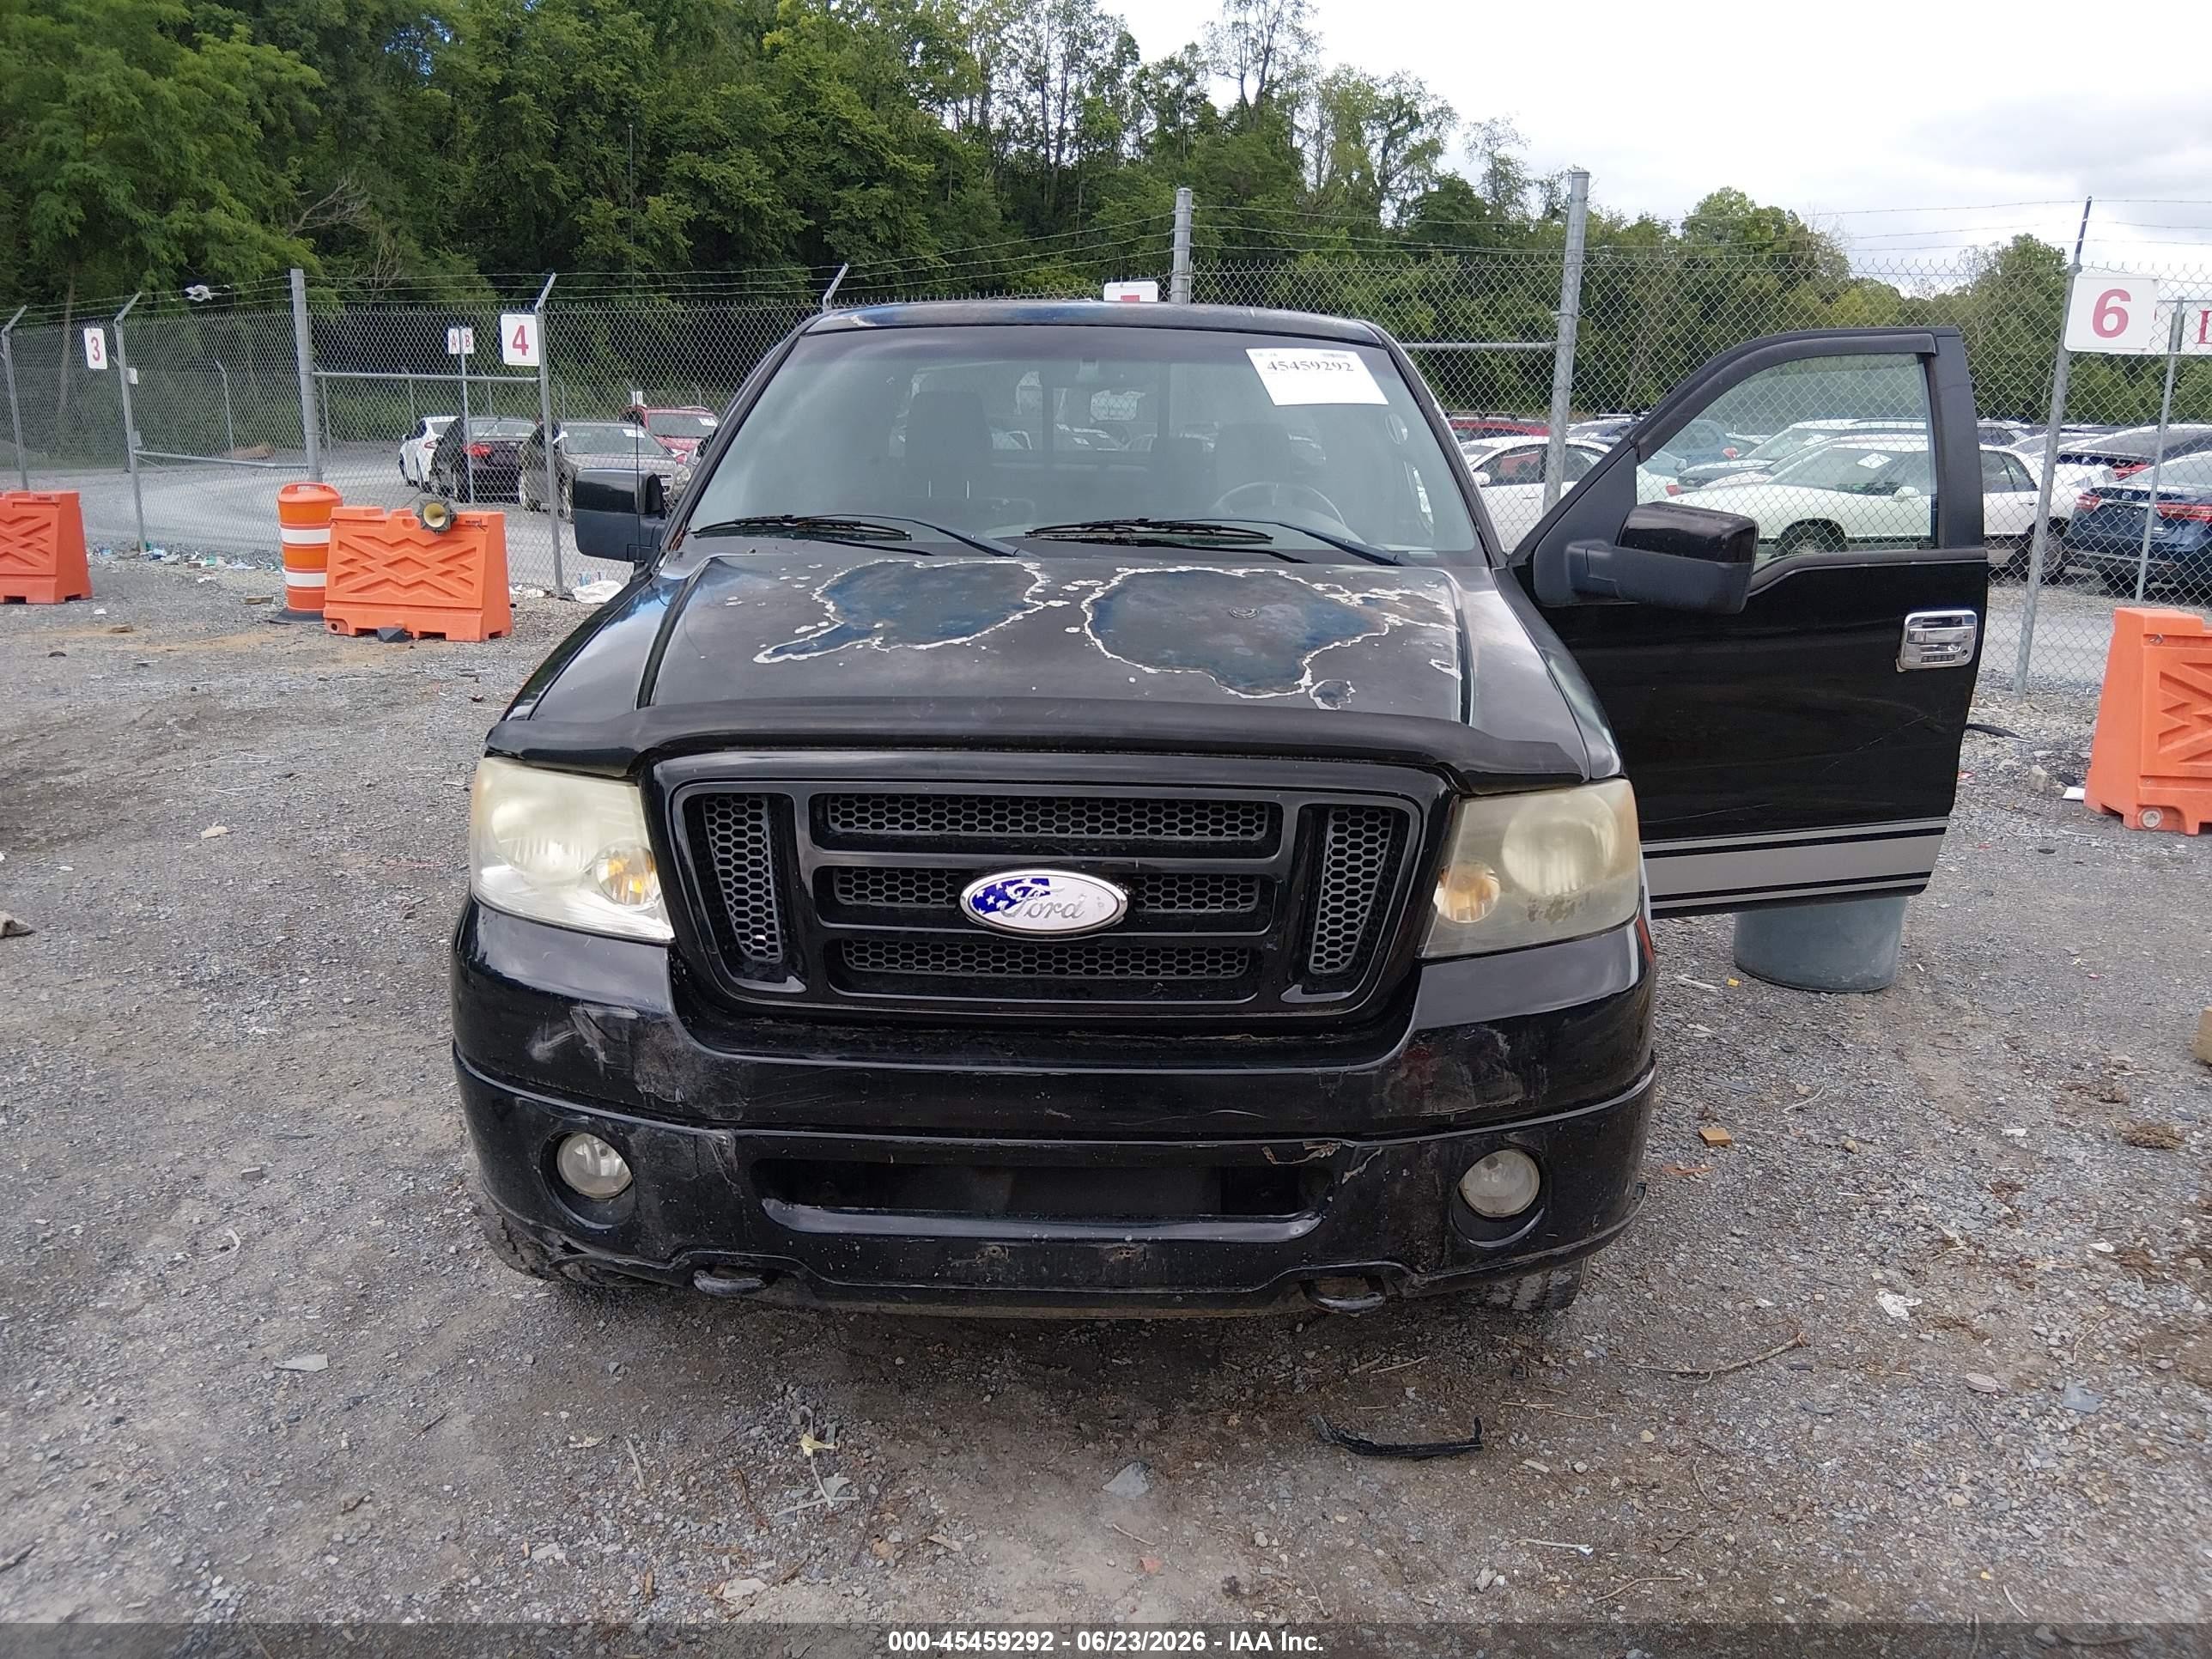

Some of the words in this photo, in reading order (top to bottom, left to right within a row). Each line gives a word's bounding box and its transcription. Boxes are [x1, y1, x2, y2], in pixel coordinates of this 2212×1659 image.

[2093, 289, 2131, 338] 6
[91, 336, 100, 362] 3
[451, 334, 457, 349] A
[465, 334, 471, 348] B
[512, 325, 529, 356] 4
[1267, 361, 1353, 372] 45459292
[1000, 881, 1086, 919] Ford
